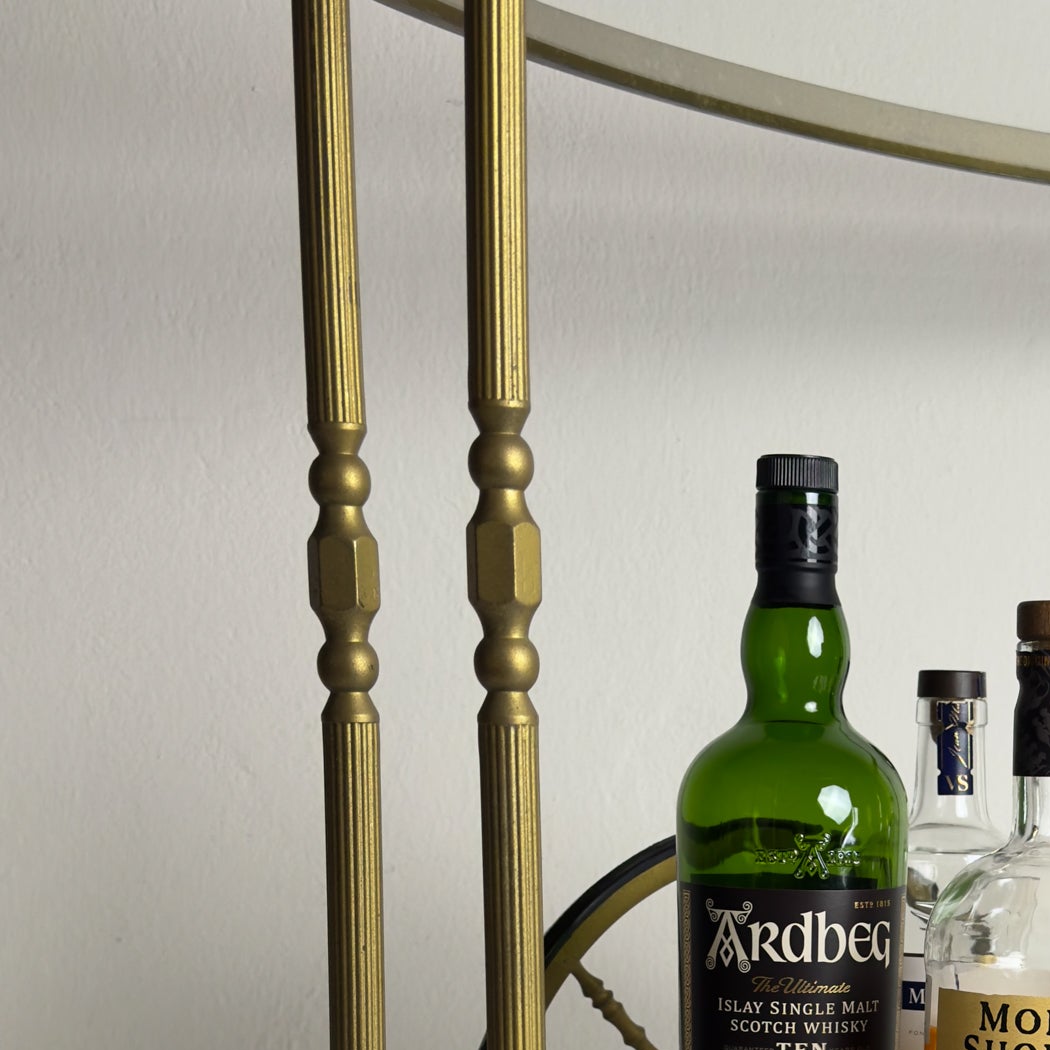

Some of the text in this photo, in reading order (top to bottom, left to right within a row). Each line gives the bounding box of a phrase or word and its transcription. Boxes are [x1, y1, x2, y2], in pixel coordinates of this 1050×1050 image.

[752, 976, 851, 994] The Ultimate
[718, 997, 880, 1016] ISLAY SINGLE MALT
[730, 1019, 869, 1034] SCOTCH WHISKY
